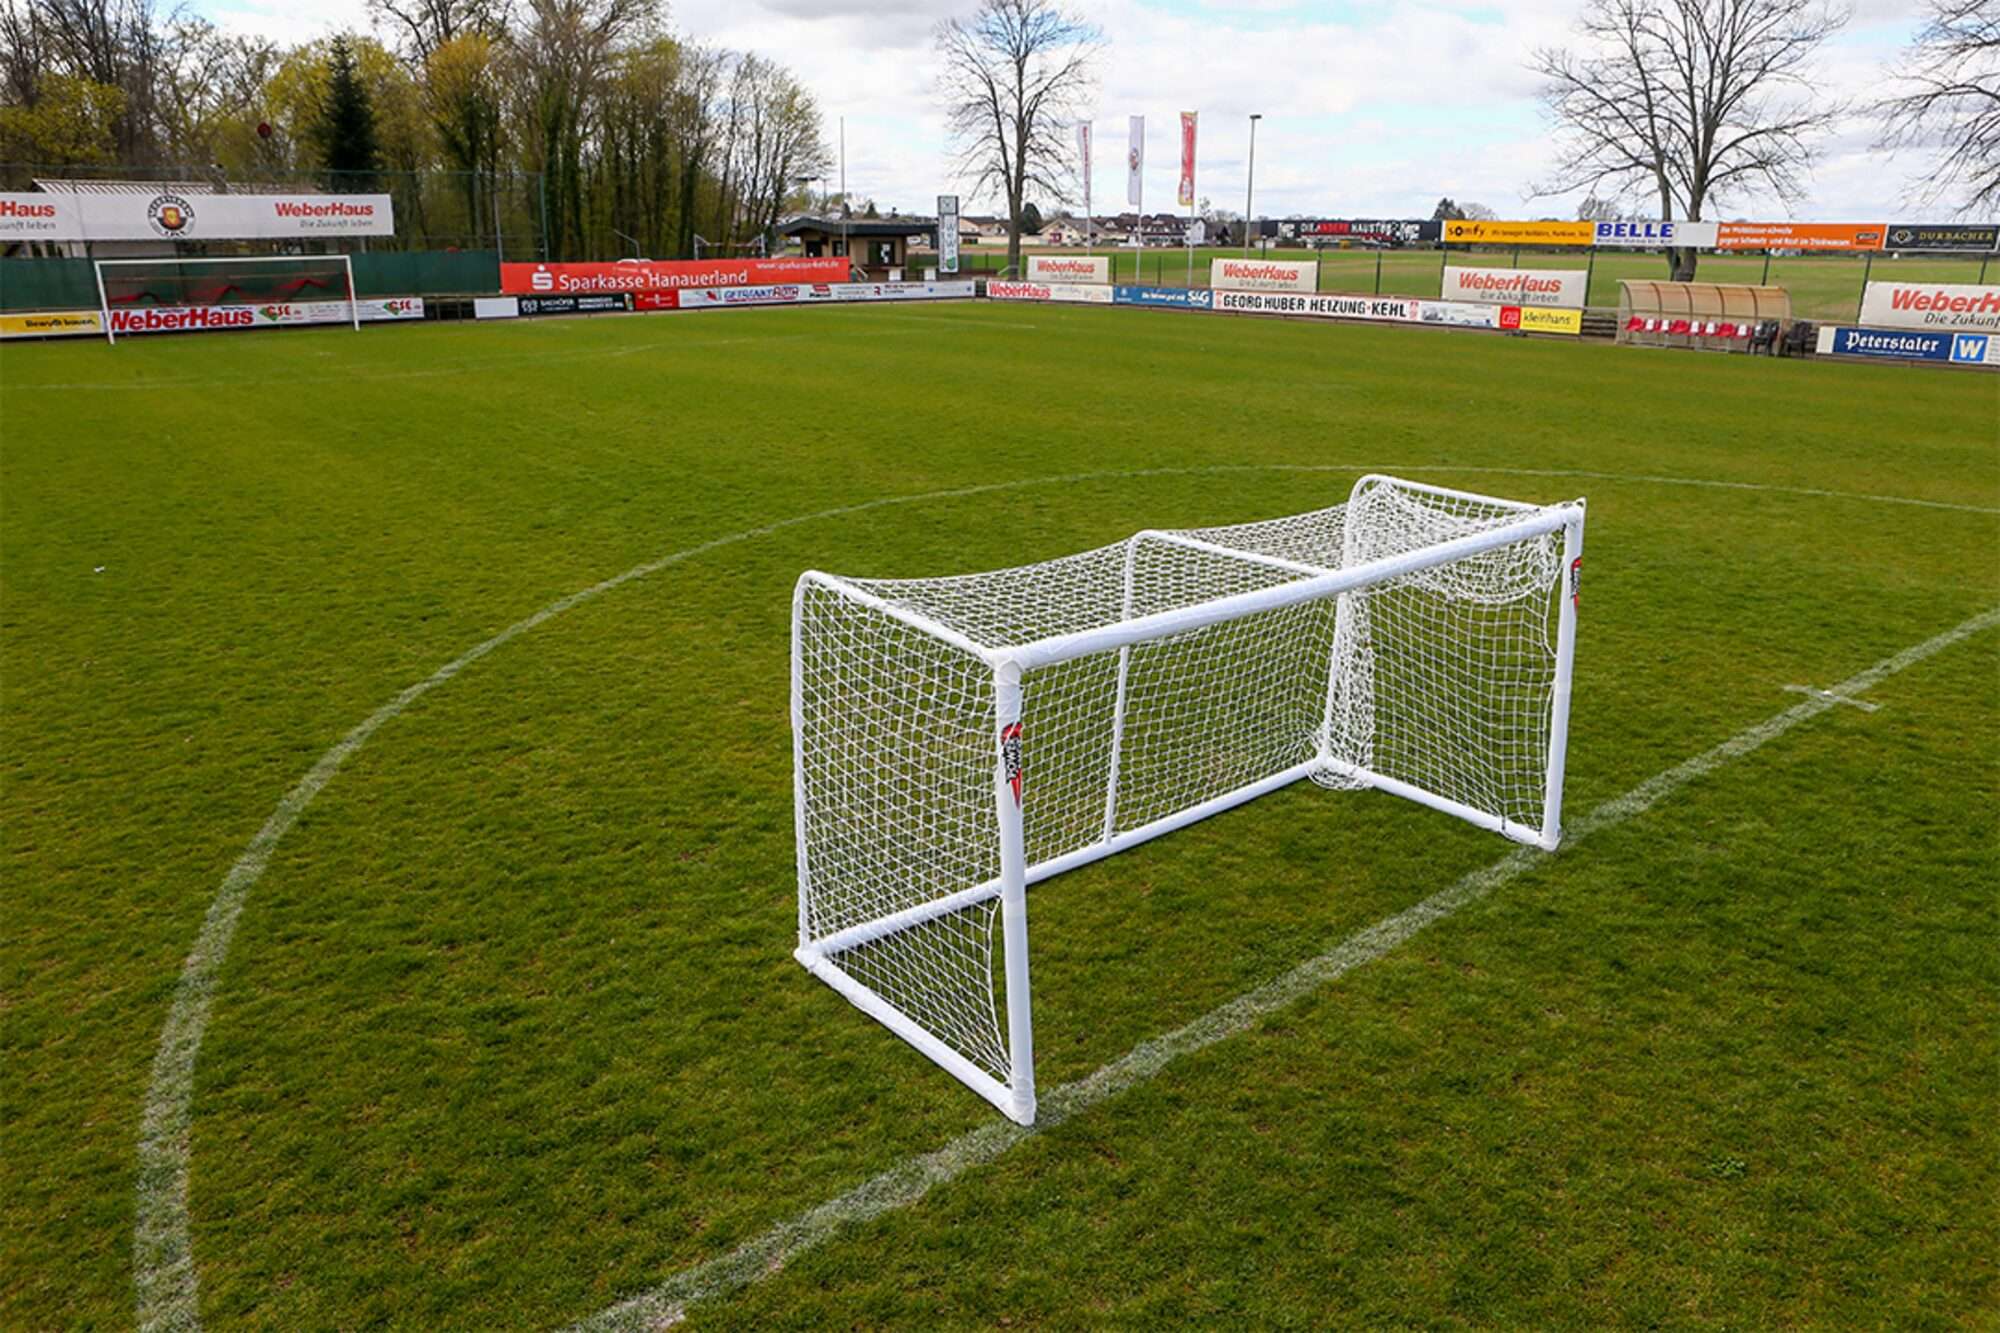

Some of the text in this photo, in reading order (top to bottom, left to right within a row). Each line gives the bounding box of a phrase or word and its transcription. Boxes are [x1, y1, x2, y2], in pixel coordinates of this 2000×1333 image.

[274, 202, 374, 217] WeberHaus
[1448, 224, 1485, 237] somfy
[1597, 223, 1675, 238] BELLE
[1919, 231, 1994, 240] DURBACHER
[1036, 260, 1096, 274] WeberHaus
[1223, 263, 1298, 281] WeberHaus
[559, 270, 748, 292] Sparkasse Hanauerland
[990, 280, 1052, 299] WeberHaus
[1459, 272, 1562, 293] WeberHaus
[1223, 294, 1407, 318] GEORG HUBER HEIZUNG KEHL
[111, 307, 255, 331] WeberHaus
[1924, 312, 1948, 324] Die
[1846, 331, 1940, 352] Peterstaler
[1958, 338, 1984, 358] W
